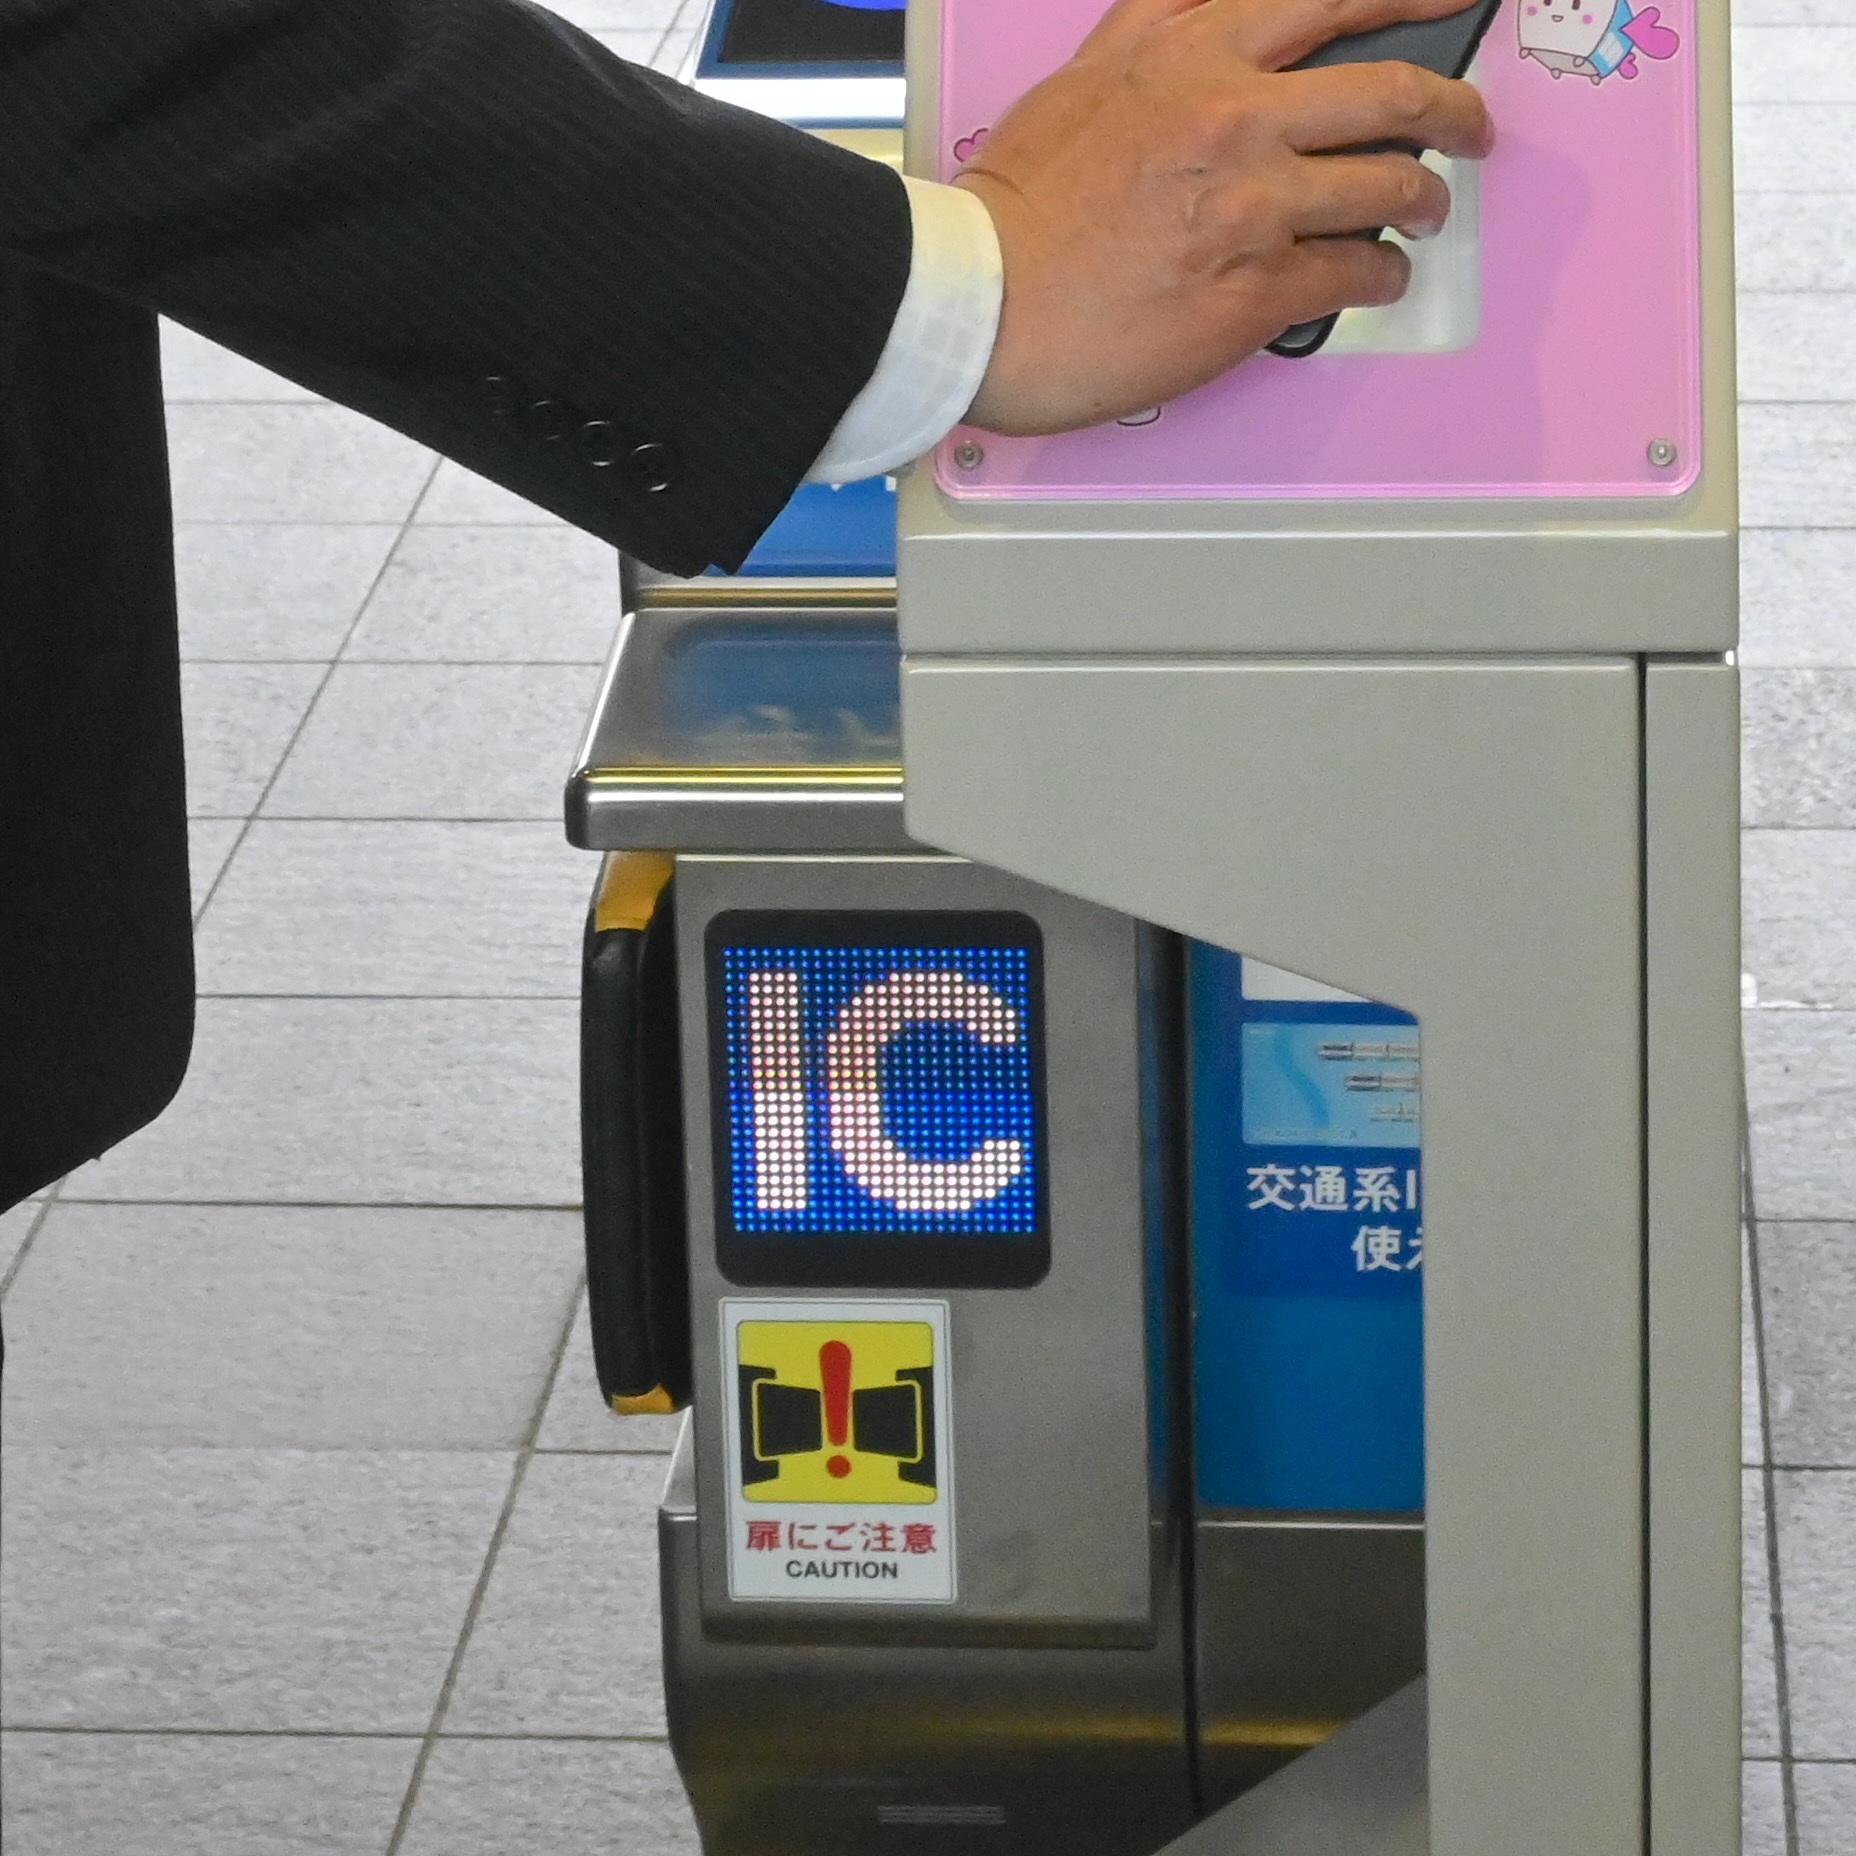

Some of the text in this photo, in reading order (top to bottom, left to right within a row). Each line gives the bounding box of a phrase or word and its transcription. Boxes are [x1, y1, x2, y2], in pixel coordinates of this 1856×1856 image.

[748, 971, 1022, 1212] IC
[745, 1519, 938, 1555] 扉にご注意
[785, 1559, 899, 1579] CAUTION
